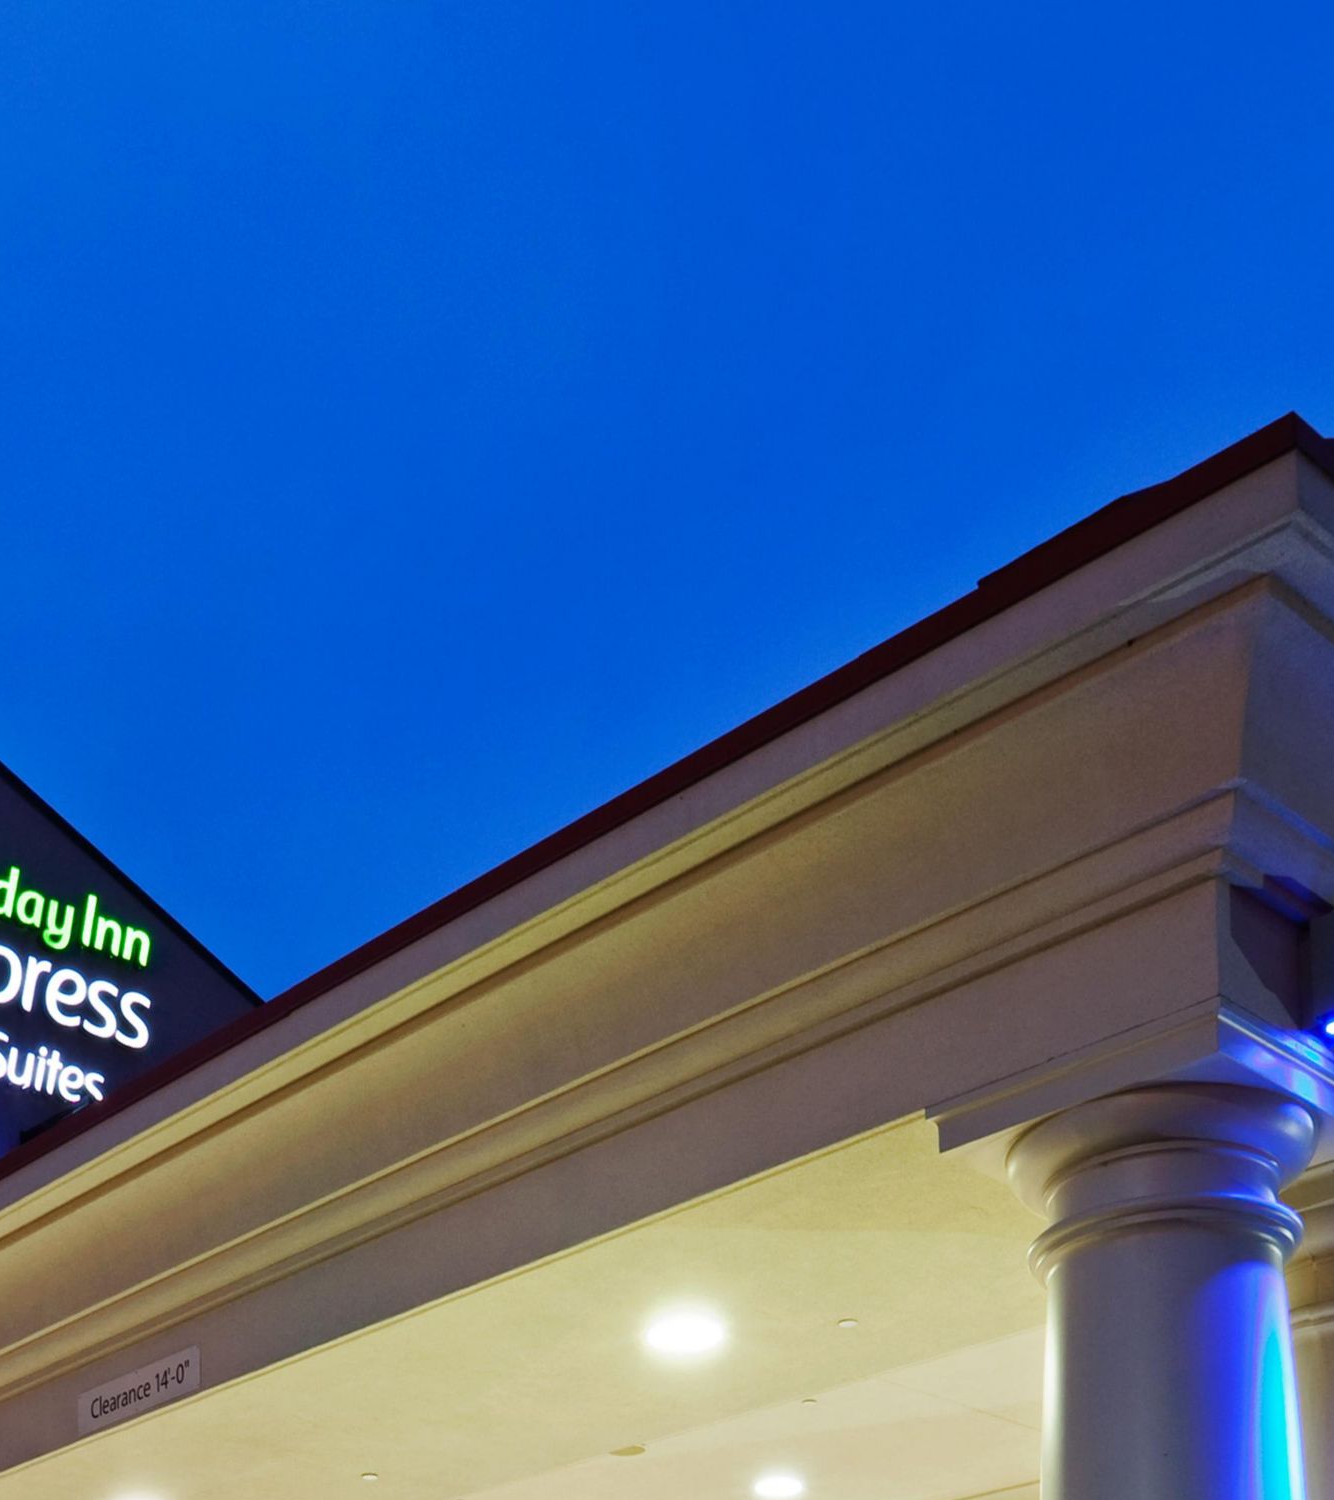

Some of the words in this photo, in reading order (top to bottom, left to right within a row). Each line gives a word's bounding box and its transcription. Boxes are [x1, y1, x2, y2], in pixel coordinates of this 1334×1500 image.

[80, 892, 152, 967] Inn
[90, 1380, 152, 1419] Clearance
[154, 1359, 191, 1393] 14'-0"
